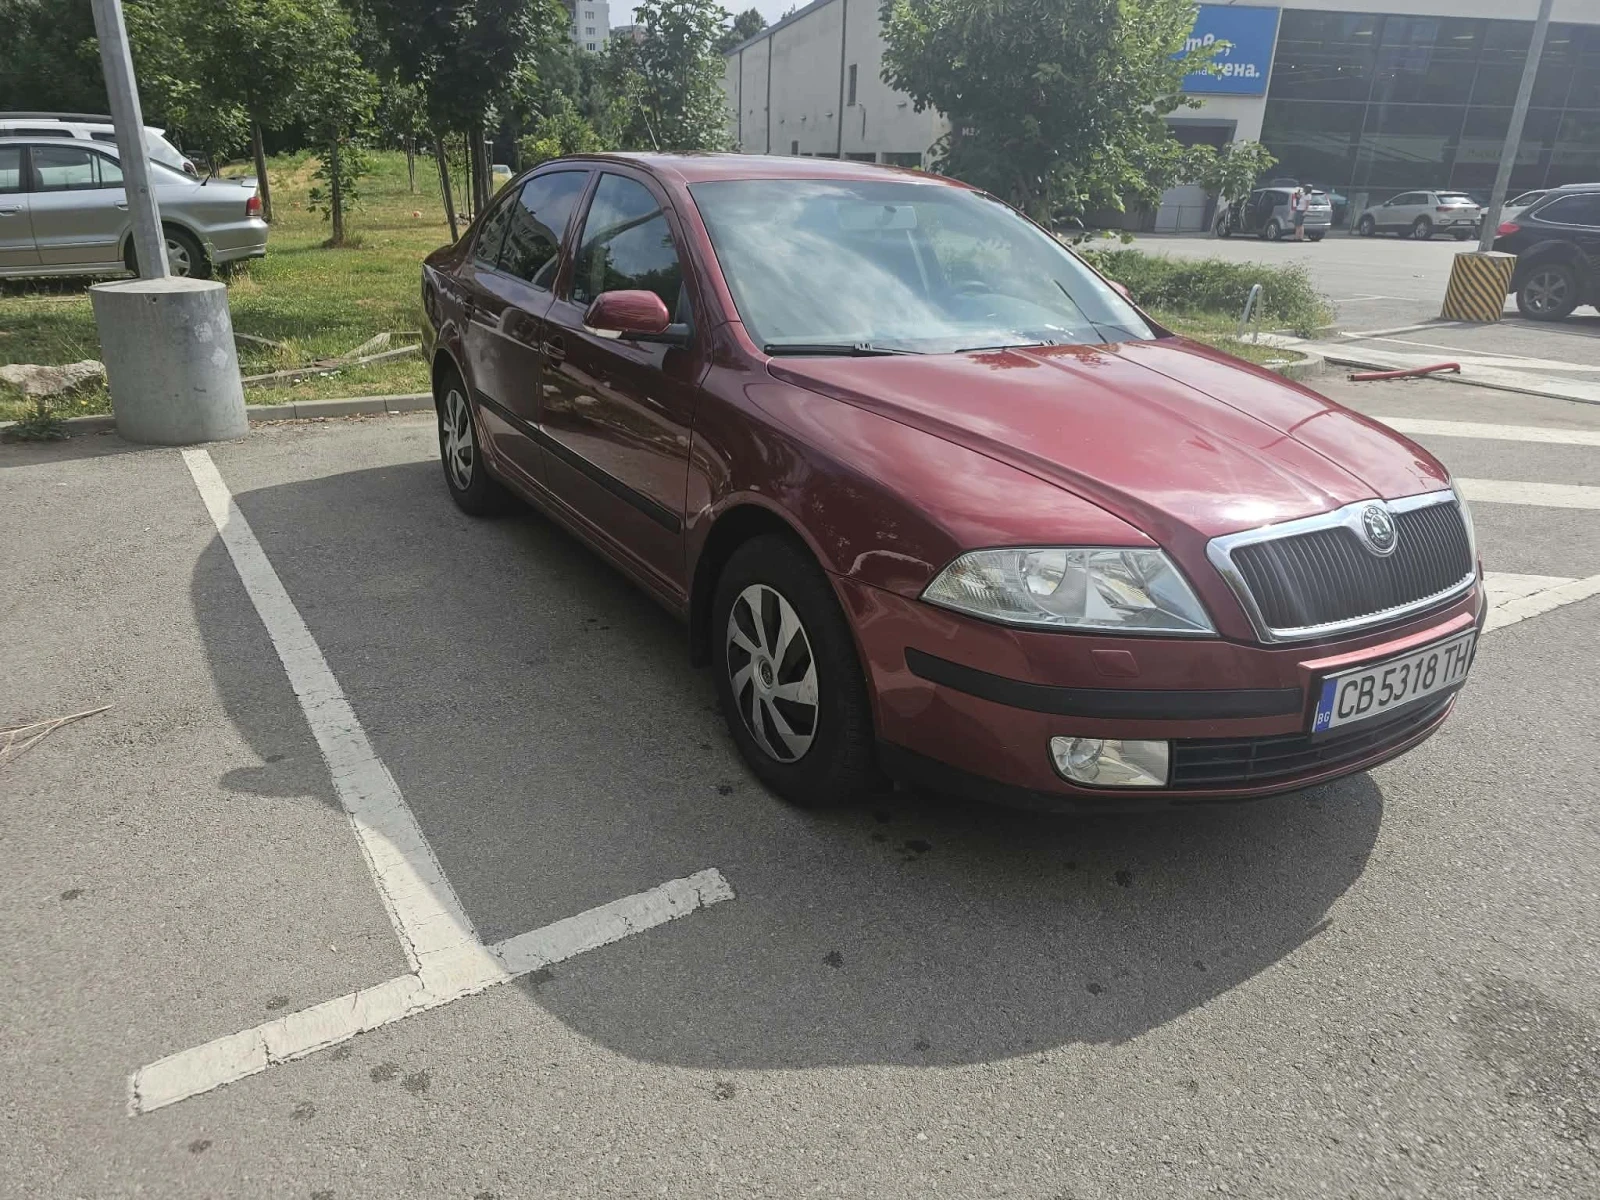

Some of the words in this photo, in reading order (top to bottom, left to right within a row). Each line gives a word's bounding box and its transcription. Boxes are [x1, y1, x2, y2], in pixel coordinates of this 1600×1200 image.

[1337, 675, 1376, 719] CB
[1379, 653, 1439, 706] 5318
[1444, 638, 1471, 682] TH
[1317, 711, 1331, 725] BG
